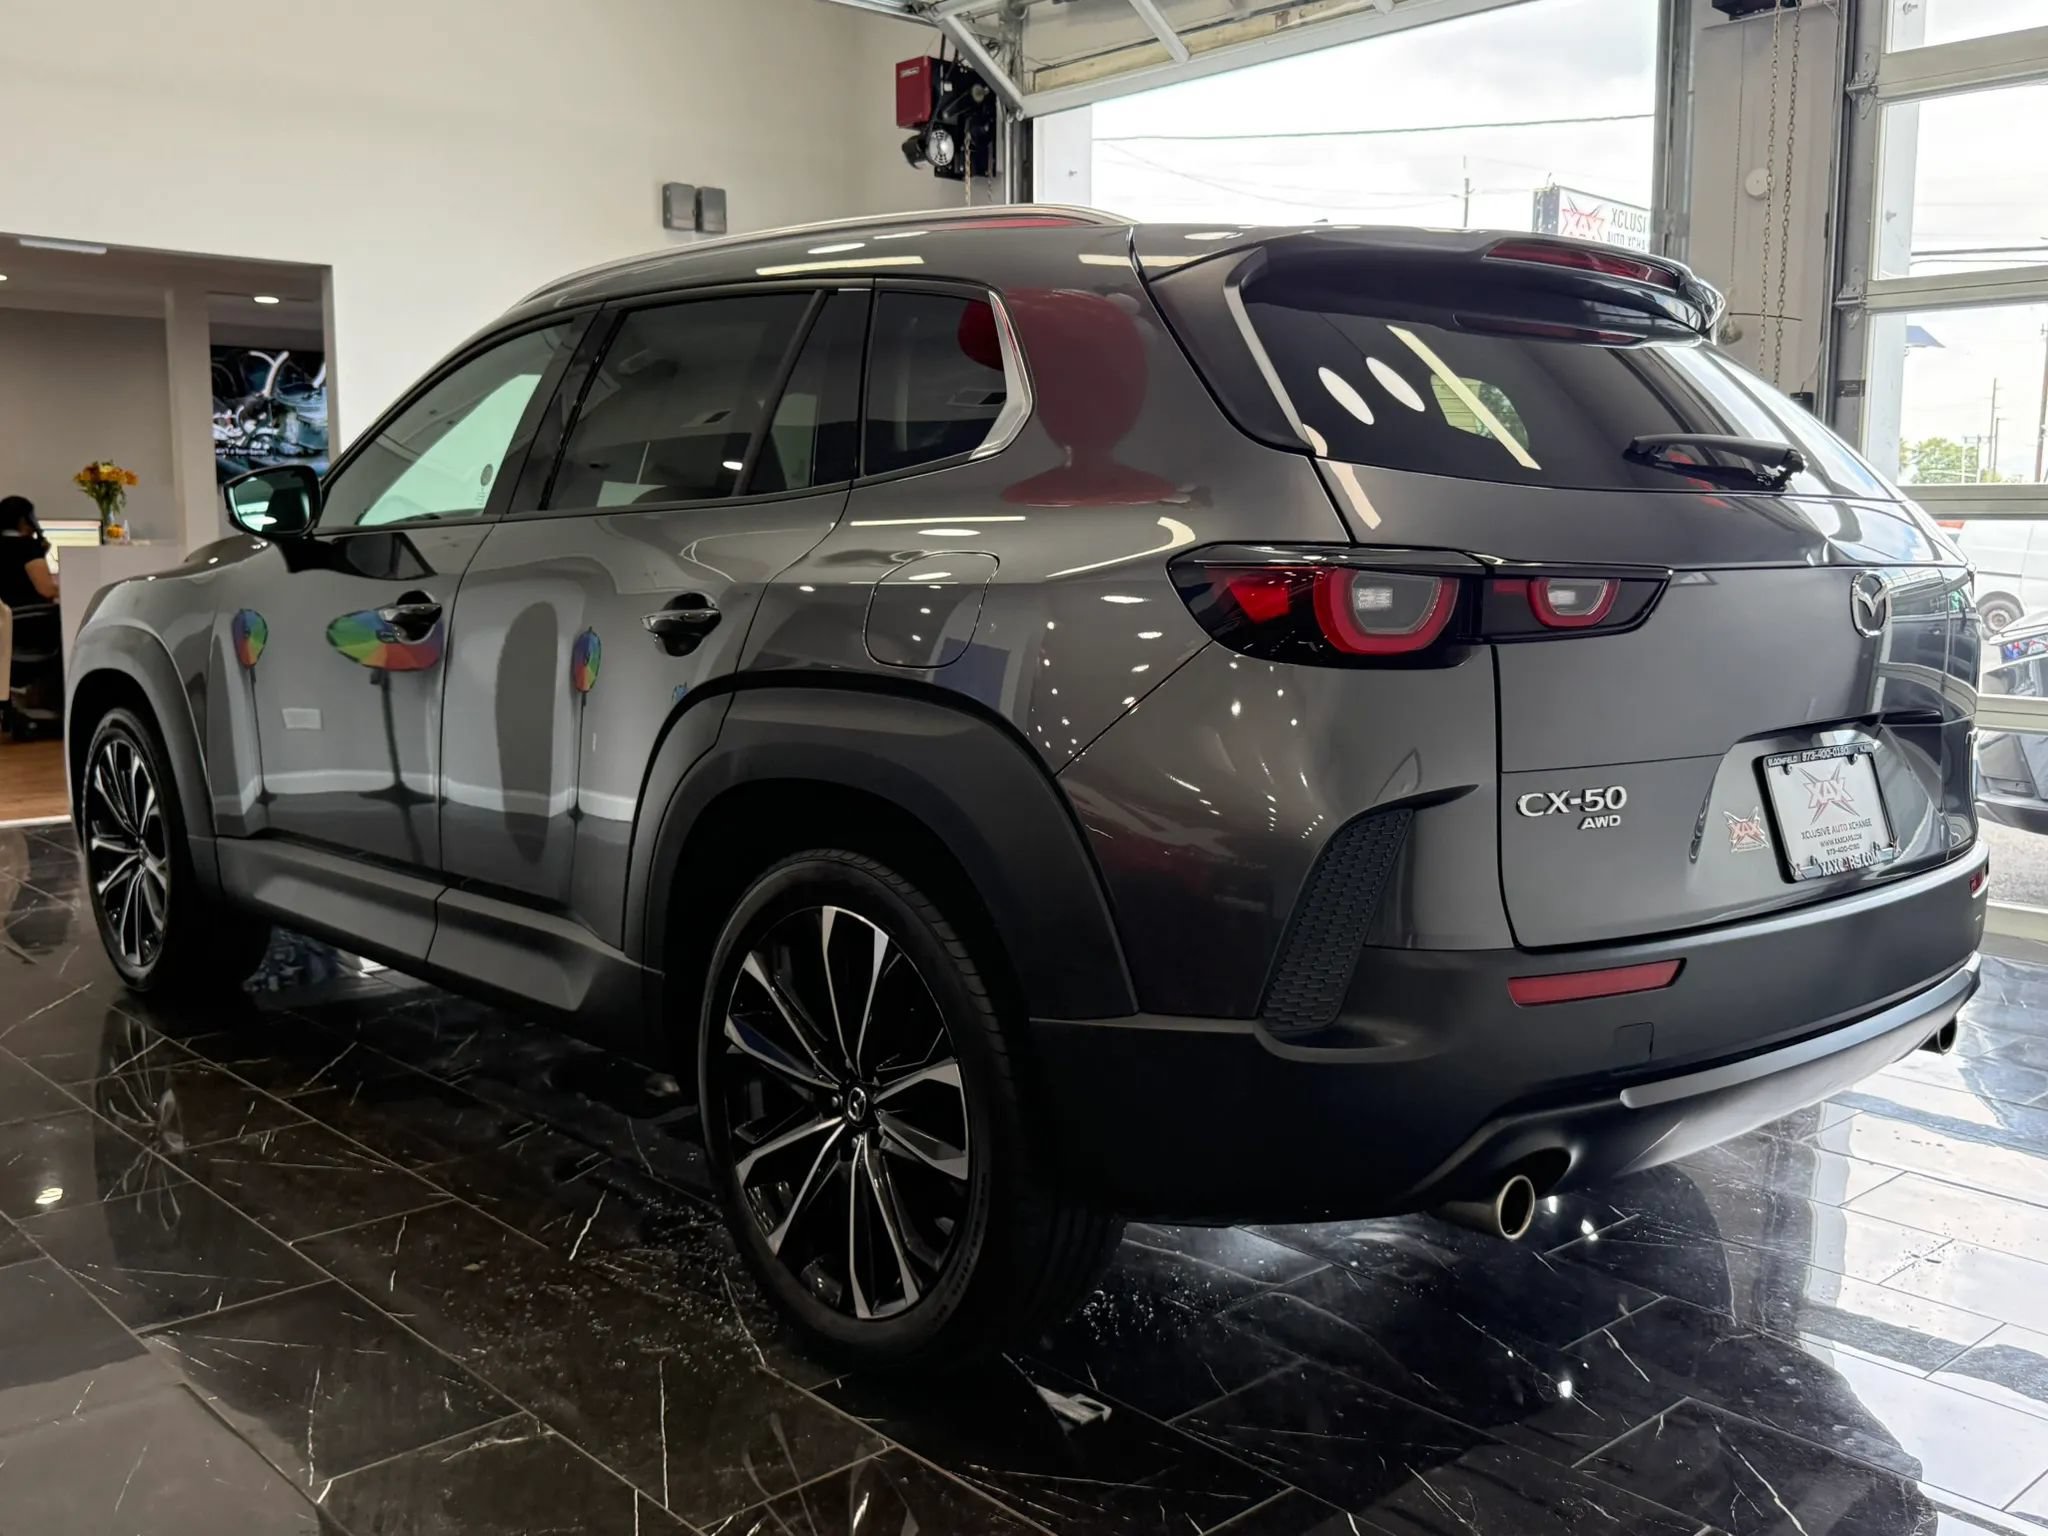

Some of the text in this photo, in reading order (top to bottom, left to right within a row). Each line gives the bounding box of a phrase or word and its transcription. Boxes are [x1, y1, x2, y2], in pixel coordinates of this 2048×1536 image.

[1610, 207, 1647, 234] XCLUSI
[1517, 785, 1628, 817] CX-50
[1580, 814, 1621, 830] AWD
[1801, 818, 1873, 841] XCLUSIVE AUTO XCHANGE
